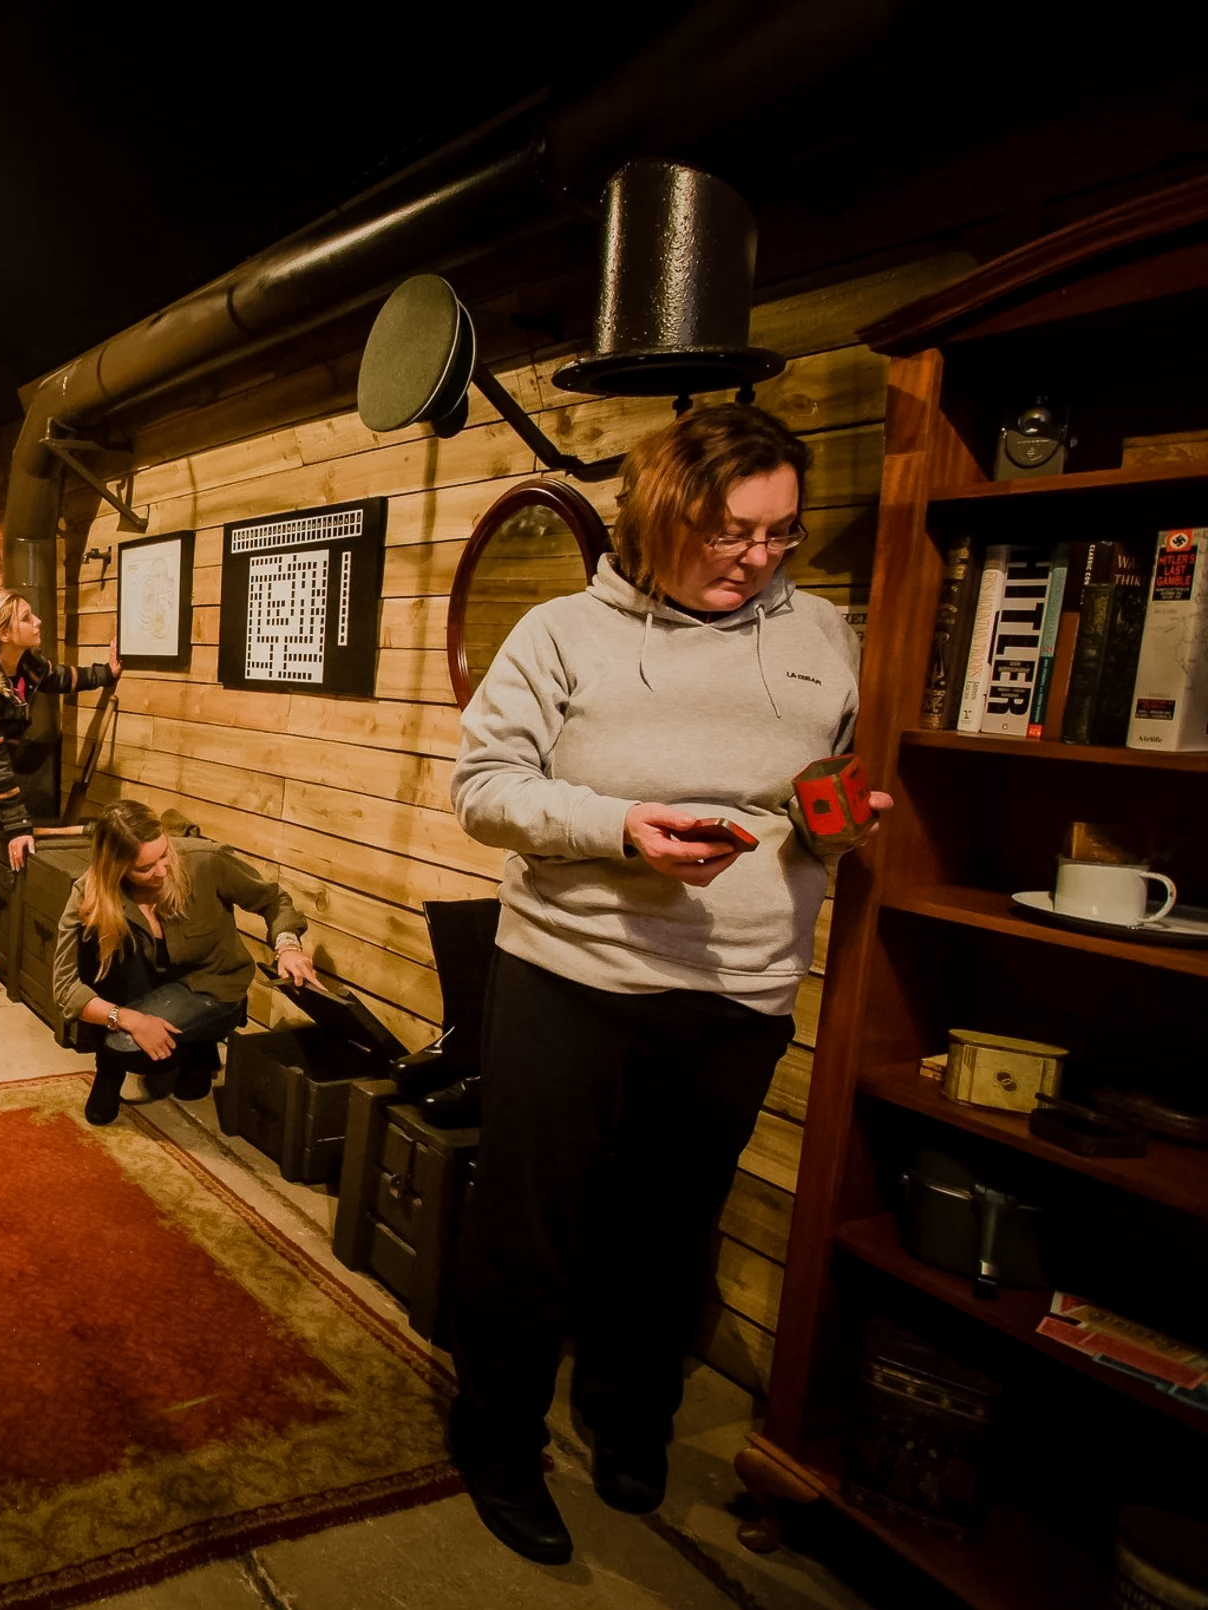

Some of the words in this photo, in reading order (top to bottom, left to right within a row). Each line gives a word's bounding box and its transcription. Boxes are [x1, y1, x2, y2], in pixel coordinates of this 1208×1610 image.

[1156, 575, 1192, 586] GAMBLE
[1164, 564, 1187, 576] LAST
[987, 548, 1051, 715] HITLER
[966, 643, 987, 678] TROOPS
